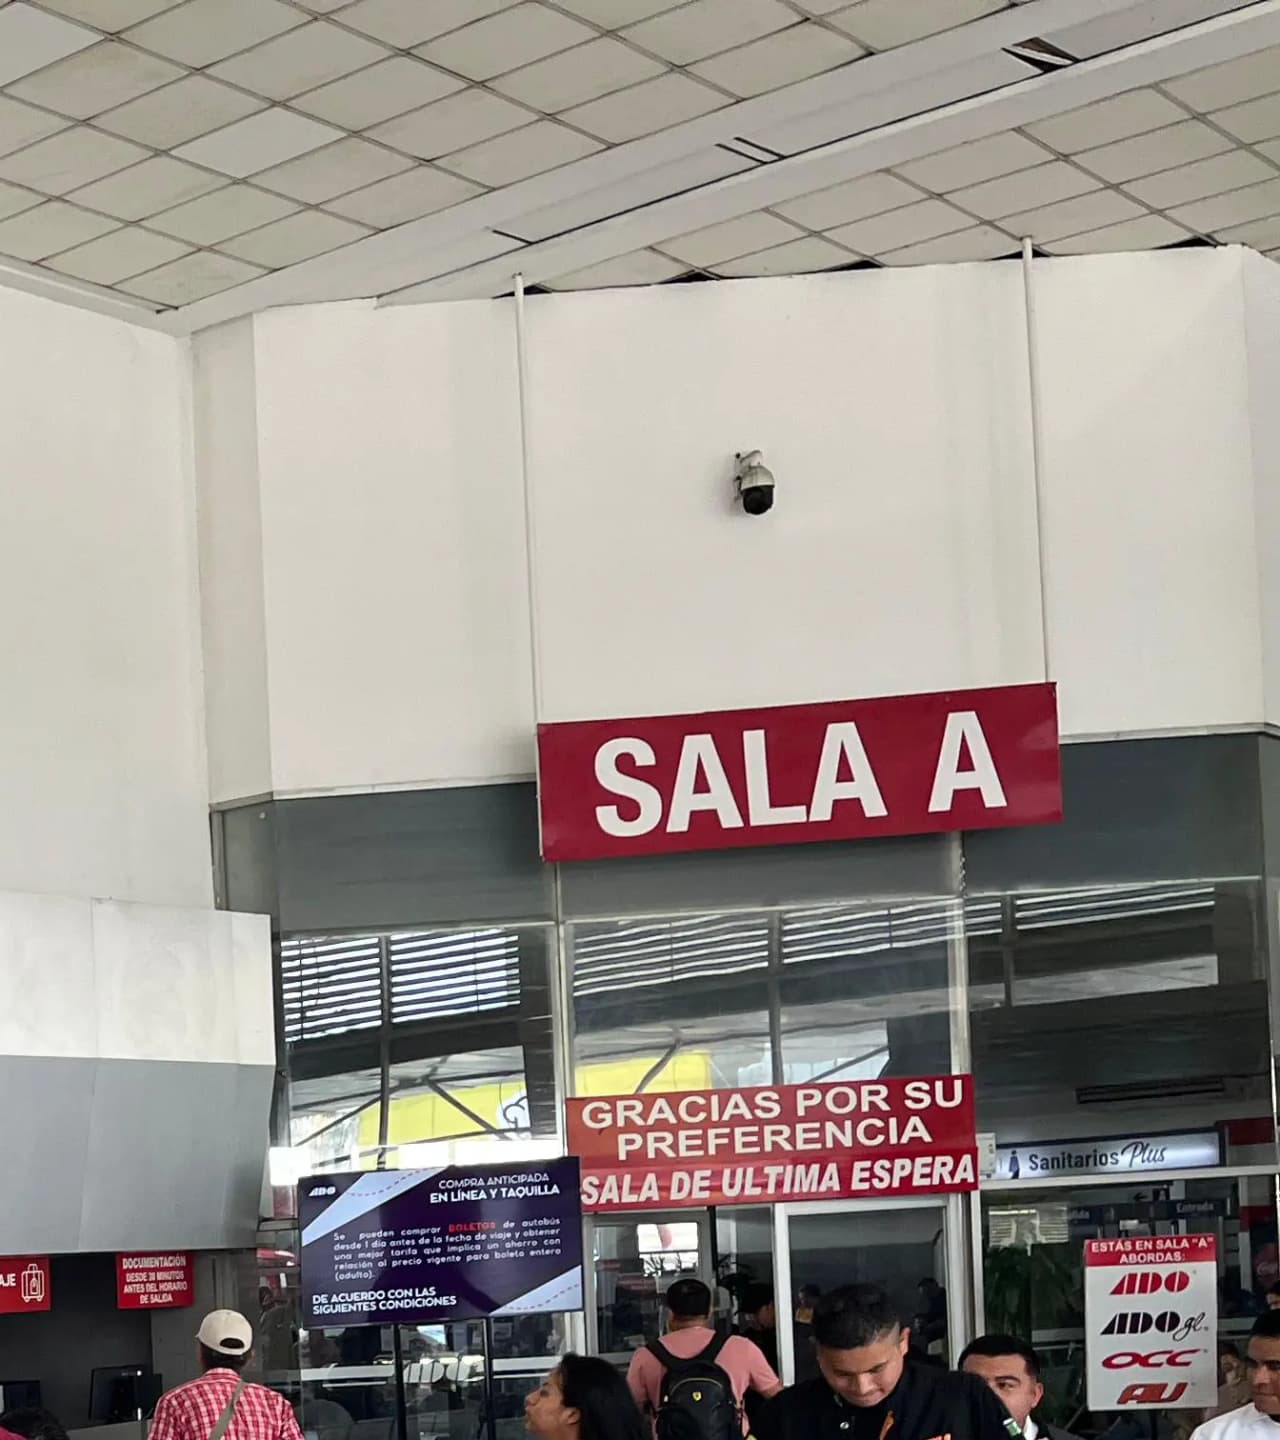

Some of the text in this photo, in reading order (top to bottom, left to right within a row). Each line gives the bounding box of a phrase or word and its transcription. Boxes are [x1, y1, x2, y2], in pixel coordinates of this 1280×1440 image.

[594, 710, 1007, 837] SALA A
[581, 1079, 963, 1129] GRACIAS POR SU
[617, 1115, 932, 1161] PREFERENCIA
[1029, 1140, 1168, 1171] Sanitarios Plus
[438, 1173, 550, 1189] COMPRA ANTICIPADA
[580, 1154, 975, 1206] SALA DE ULTIMA ESPERA
[429, 1184, 560, 1203] EN LÍNEA Y TAQUILLA
[1091, 1235, 1214, 1253] ESTÁS EN SALA "A"
[122, 1253, 186, 1269] DOCUMENTACIÓN
[145, 1282, 158, 1293] DEL
[1109, 1271, 1190, 1296] ADO
[140, 1294, 149, 1304] DE
[312, 1286, 437, 1304] DE ACUERDO CON LAS
[312, 1296, 457, 1315] SIGUIENTES CONDICIONES
[1101, 1349, 1201, 1370] OCC
